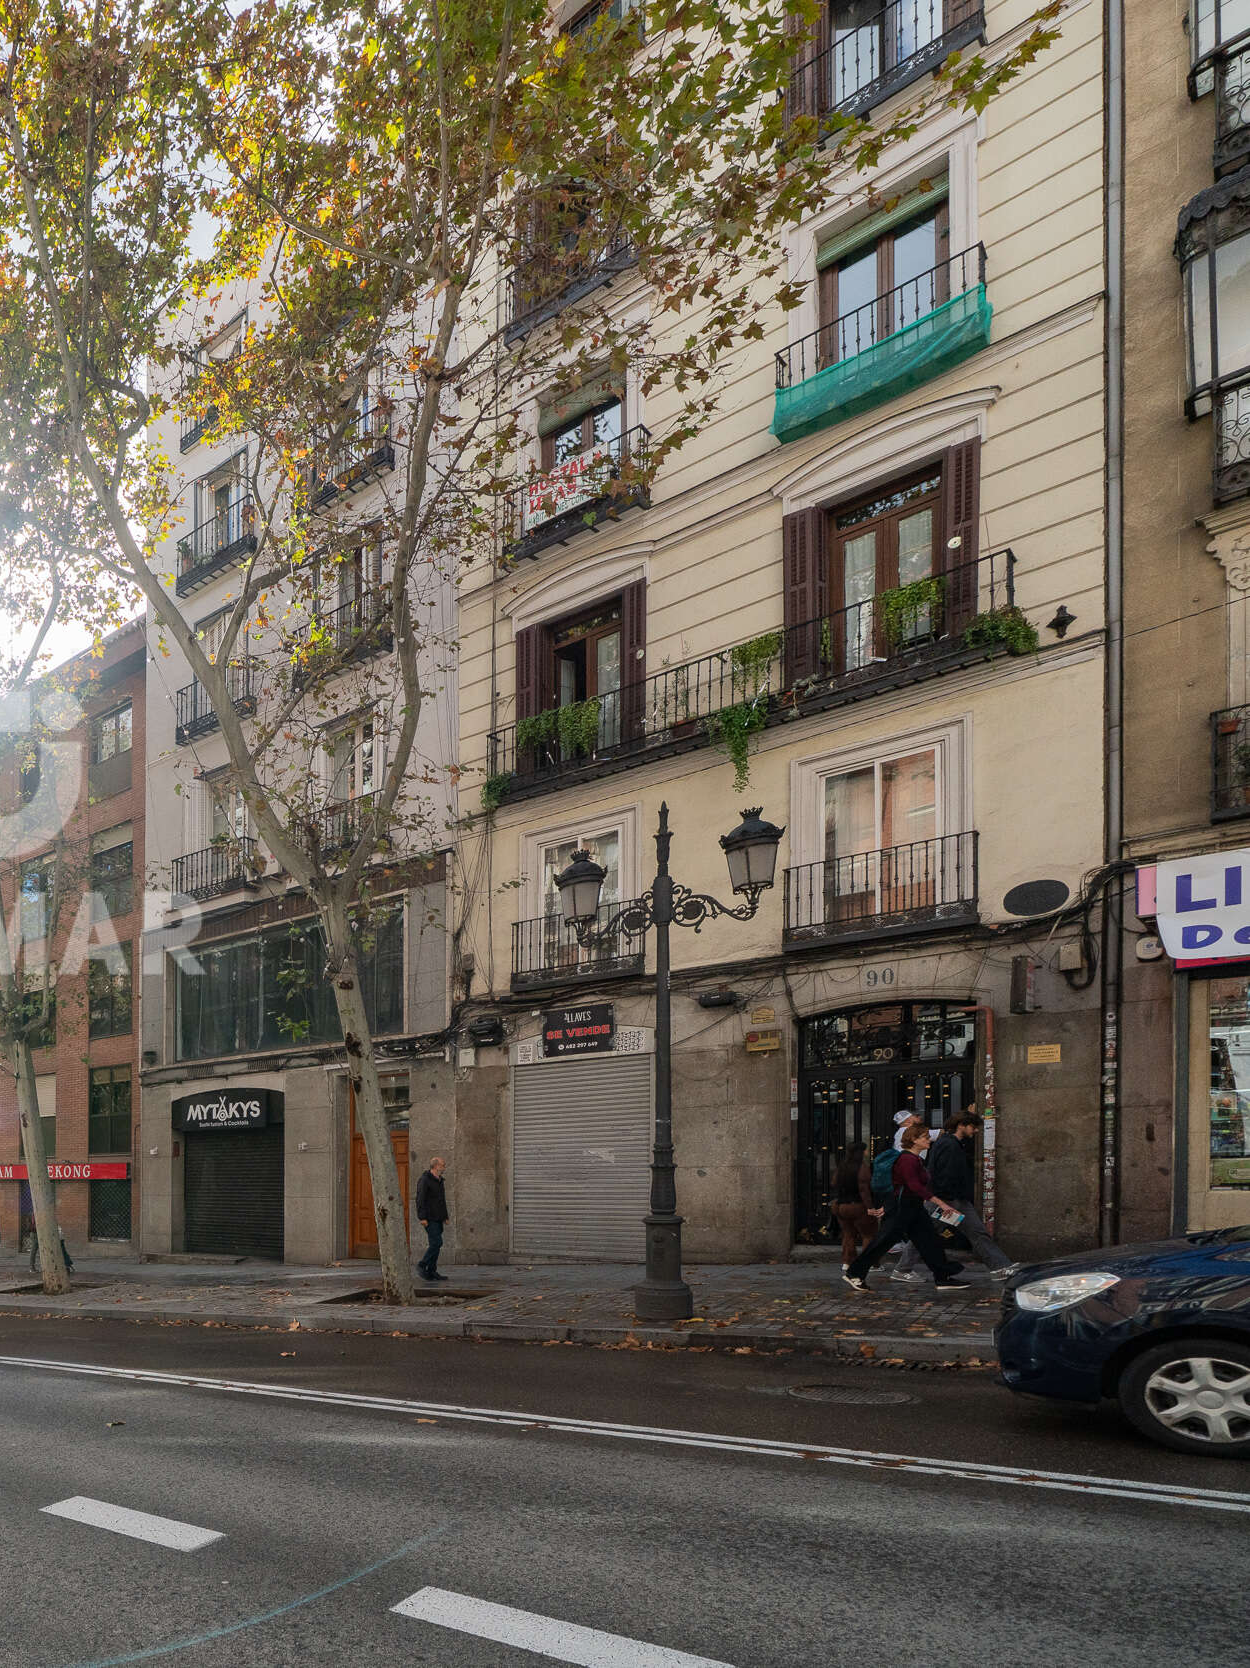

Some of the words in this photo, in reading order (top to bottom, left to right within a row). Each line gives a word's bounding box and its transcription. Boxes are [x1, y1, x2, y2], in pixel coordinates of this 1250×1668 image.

[866, 968, 895, 986] 90
[546, 1030, 563, 1040] SE
[566, 1024, 611, 1038] VENDE
[873, 1047, 894, 1060] 90
[187, 1096, 261, 1121] MYTAKYS
[48, 1165, 92, 1178] EKONG
